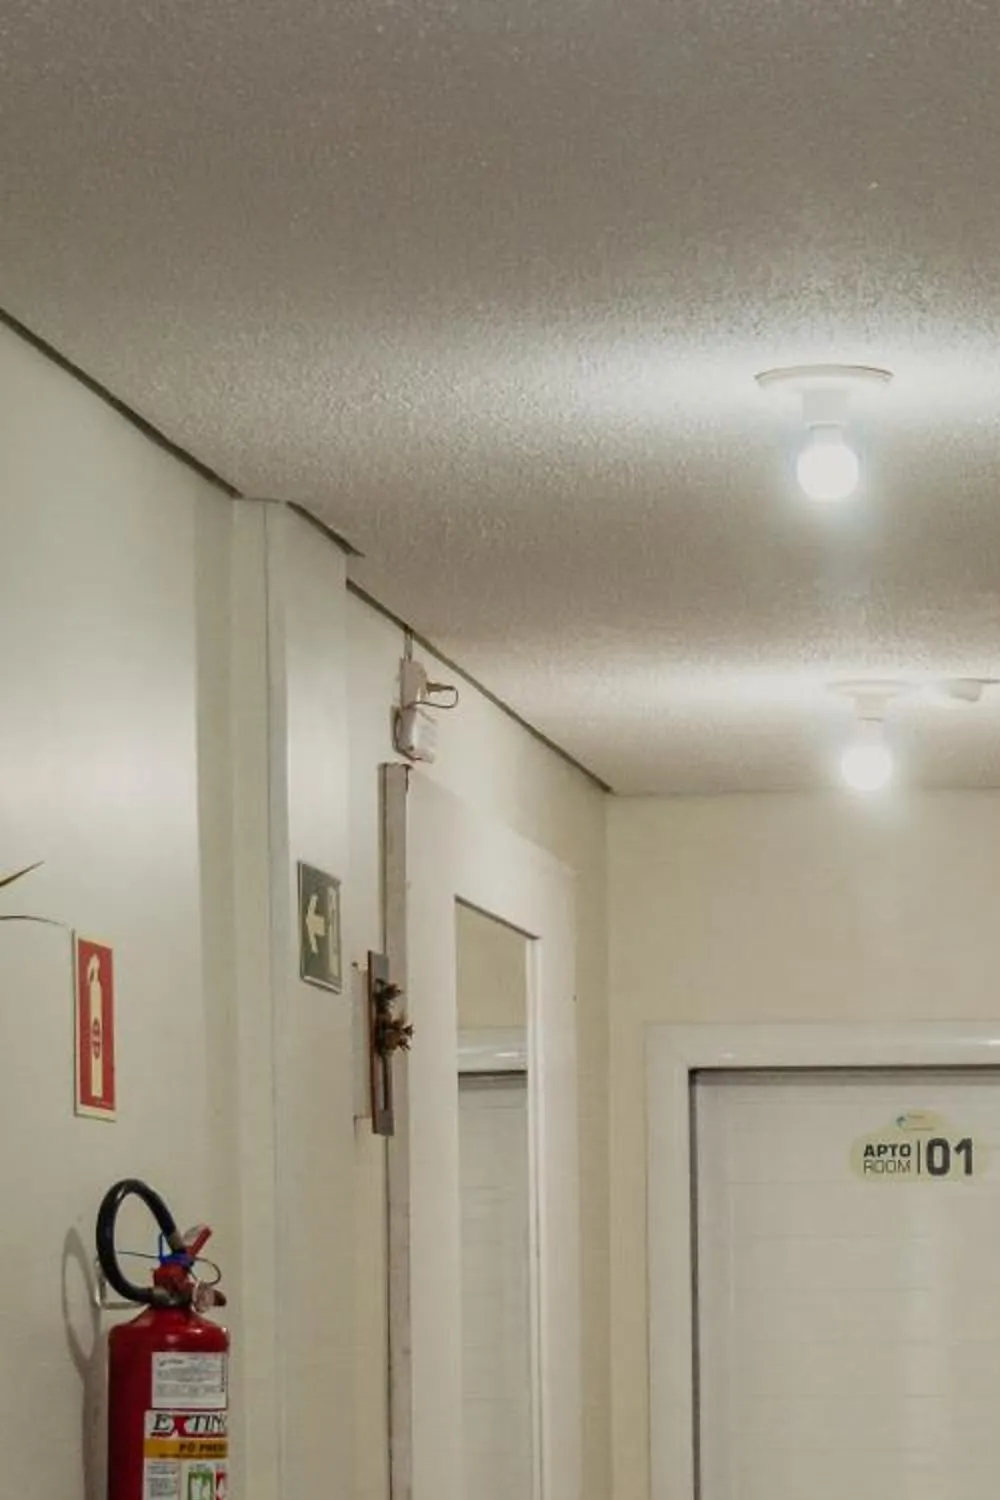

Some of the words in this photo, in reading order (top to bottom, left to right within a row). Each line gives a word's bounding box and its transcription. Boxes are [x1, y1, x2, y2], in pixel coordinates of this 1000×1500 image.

[863, 1143, 912, 1158] APTO
[926, 1137, 973, 1176] 01
[863, 1159, 911, 1174] ROOM
